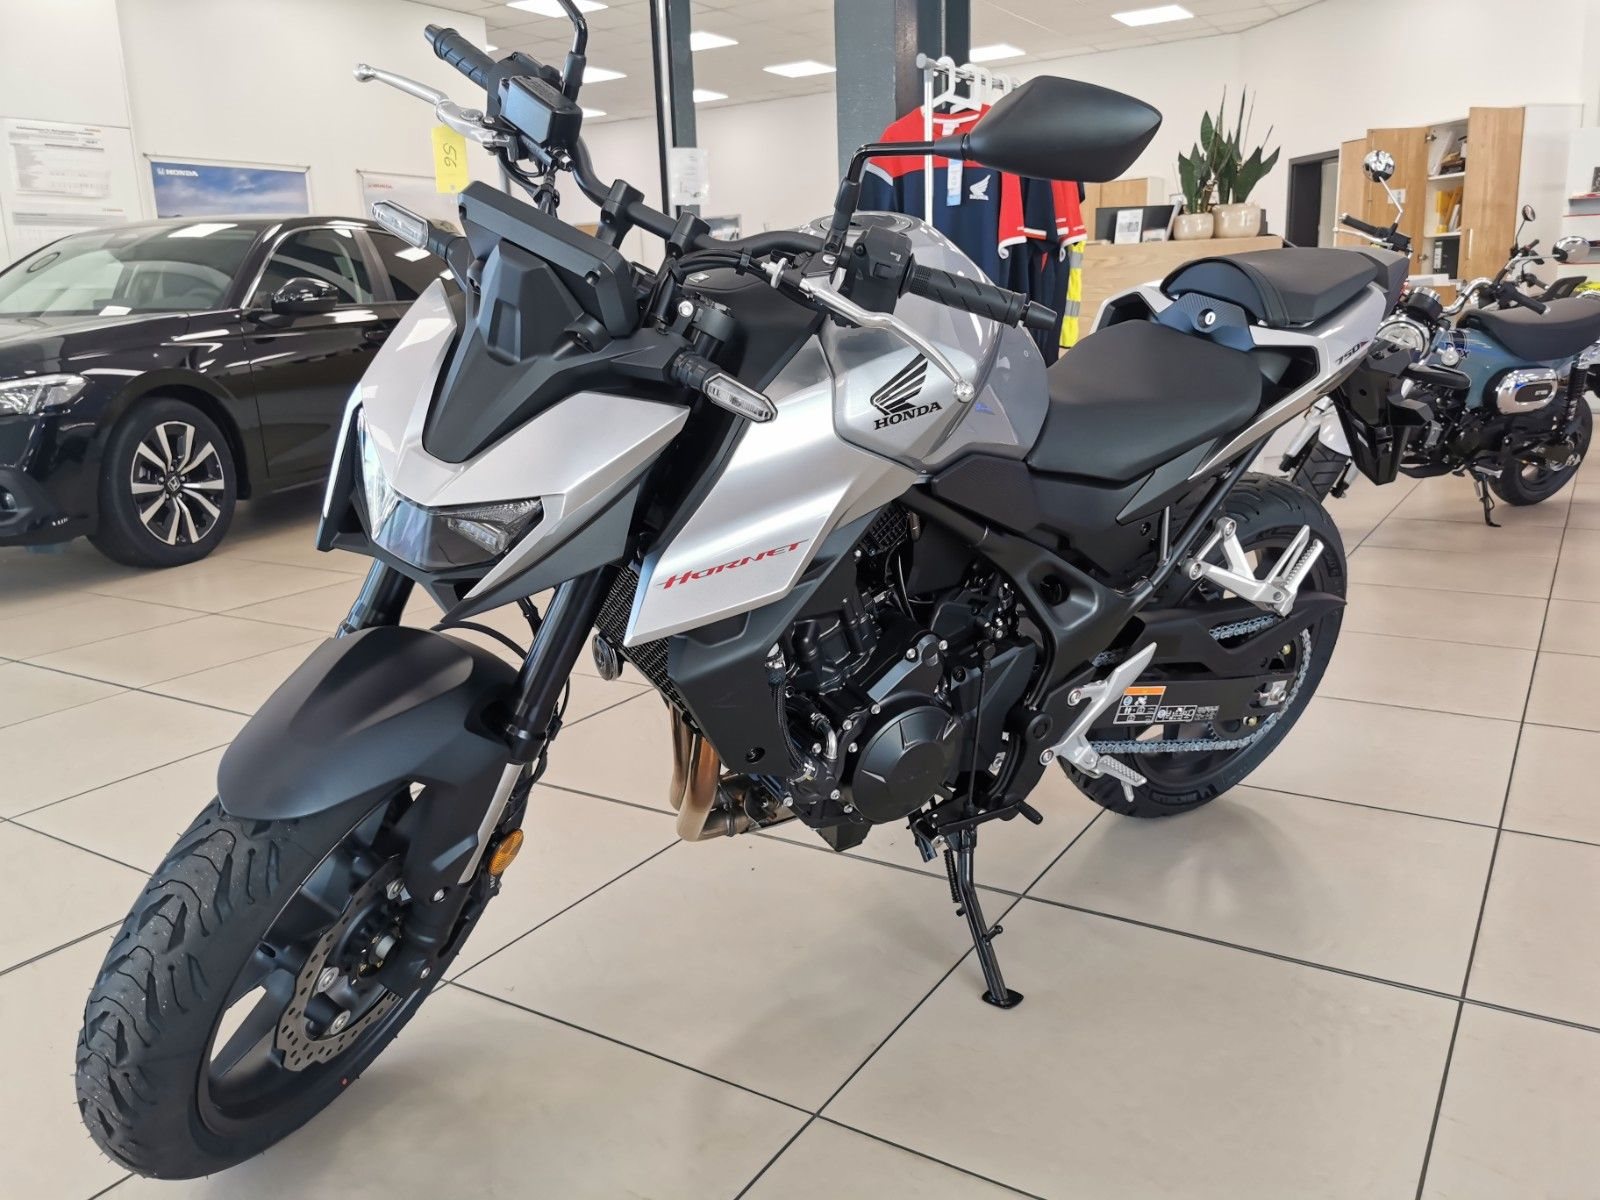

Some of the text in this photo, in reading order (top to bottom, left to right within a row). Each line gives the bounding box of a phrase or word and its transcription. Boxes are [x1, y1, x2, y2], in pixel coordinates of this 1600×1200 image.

[165, 168, 199, 177] HONDA
[1335, 343, 1361, 365] 750
[873, 401, 943, 431] HONDA
[656, 539, 810, 589] HORNET
